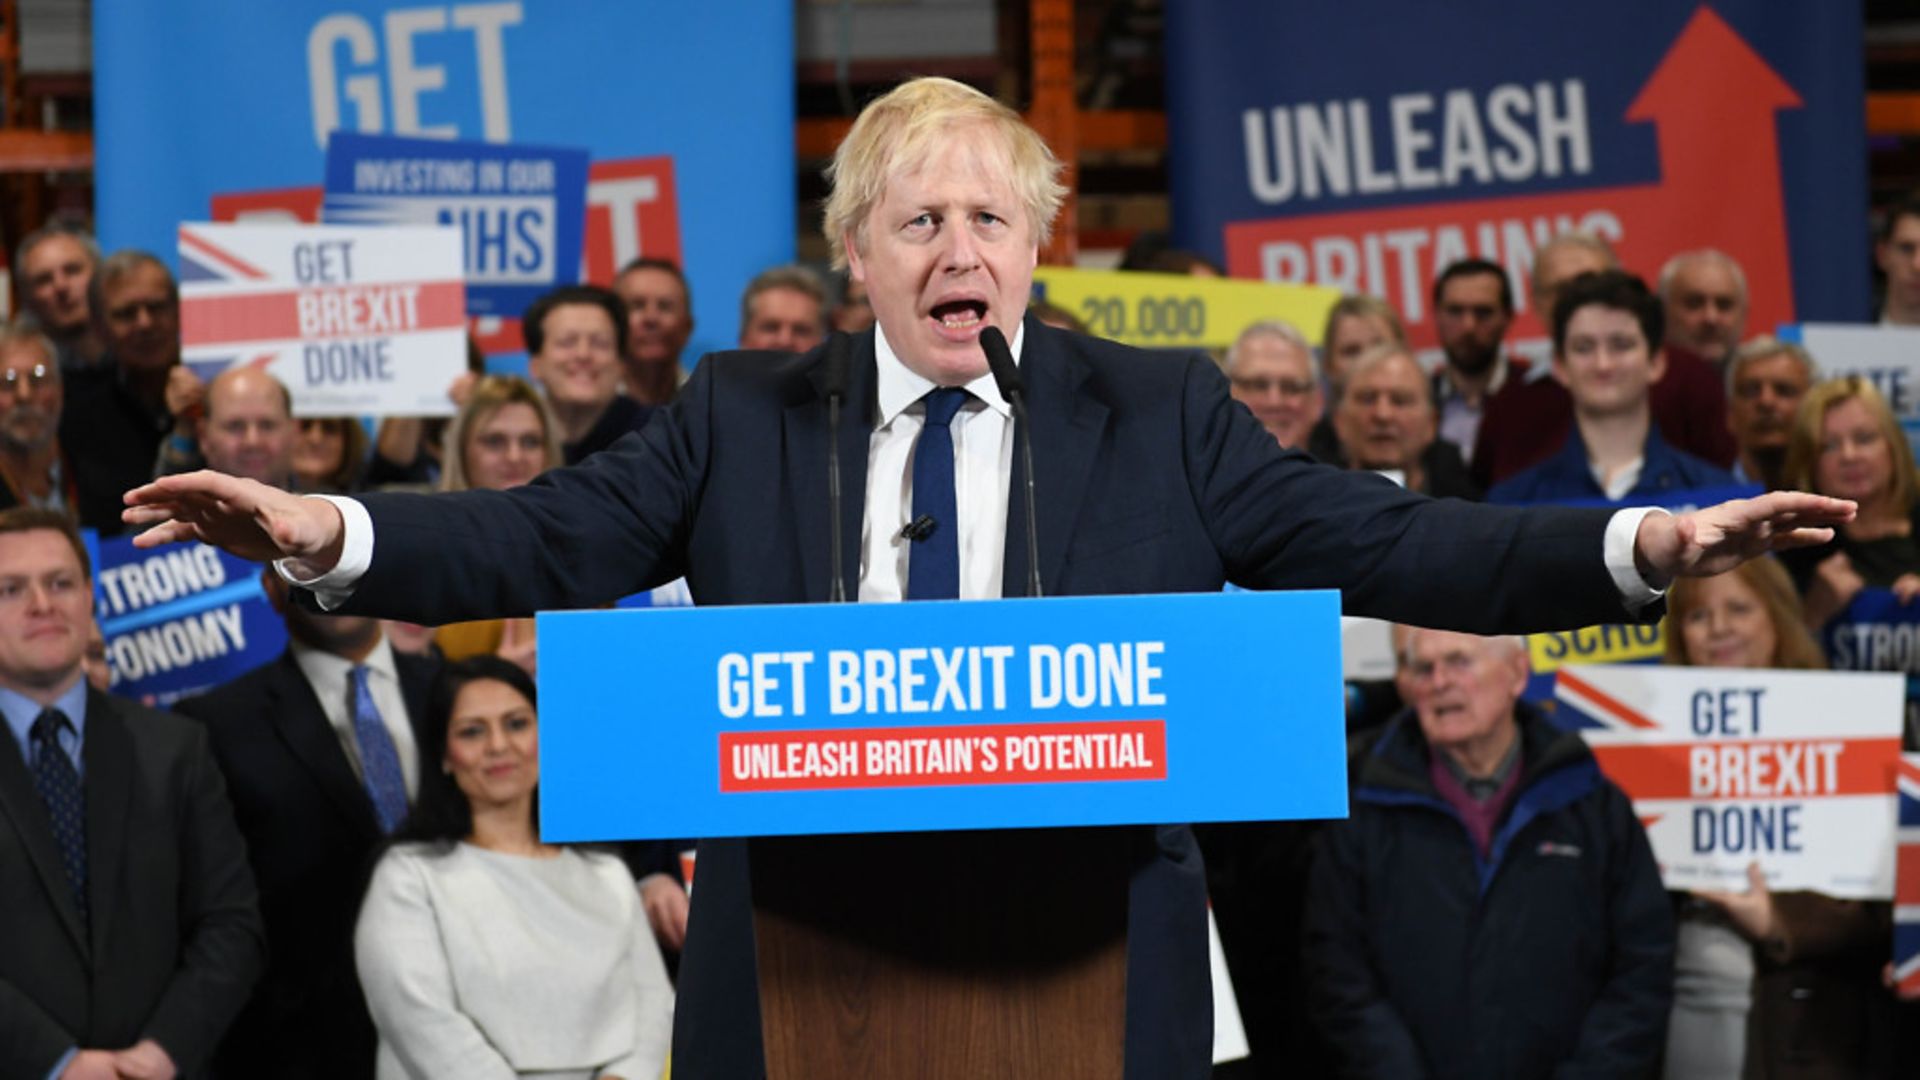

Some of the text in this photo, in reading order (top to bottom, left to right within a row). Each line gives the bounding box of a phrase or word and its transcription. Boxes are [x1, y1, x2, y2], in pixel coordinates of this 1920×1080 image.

[308, 3, 522, 149] GET
[1244, 80, 1591, 204] UNLEASH
[355, 160, 555, 193] INVESTING IN OUR
[294, 240, 353, 283] GET
[300, 286, 419, 336] BREXIT
[304, 339, 394, 385] DONE
[99, 543, 226, 615] TRONG
[1834, 622, 1920, 671] STRO
[717, 641, 1167, 718] GET BREXIT DONE
[1691, 687, 1766, 736] GET
[732, 732, 1153, 780] UNLEASH BRITAIN'S POTENTIAL
[1690, 742, 1844, 798] BREXIT
[1692, 805, 1803, 854] DONE
